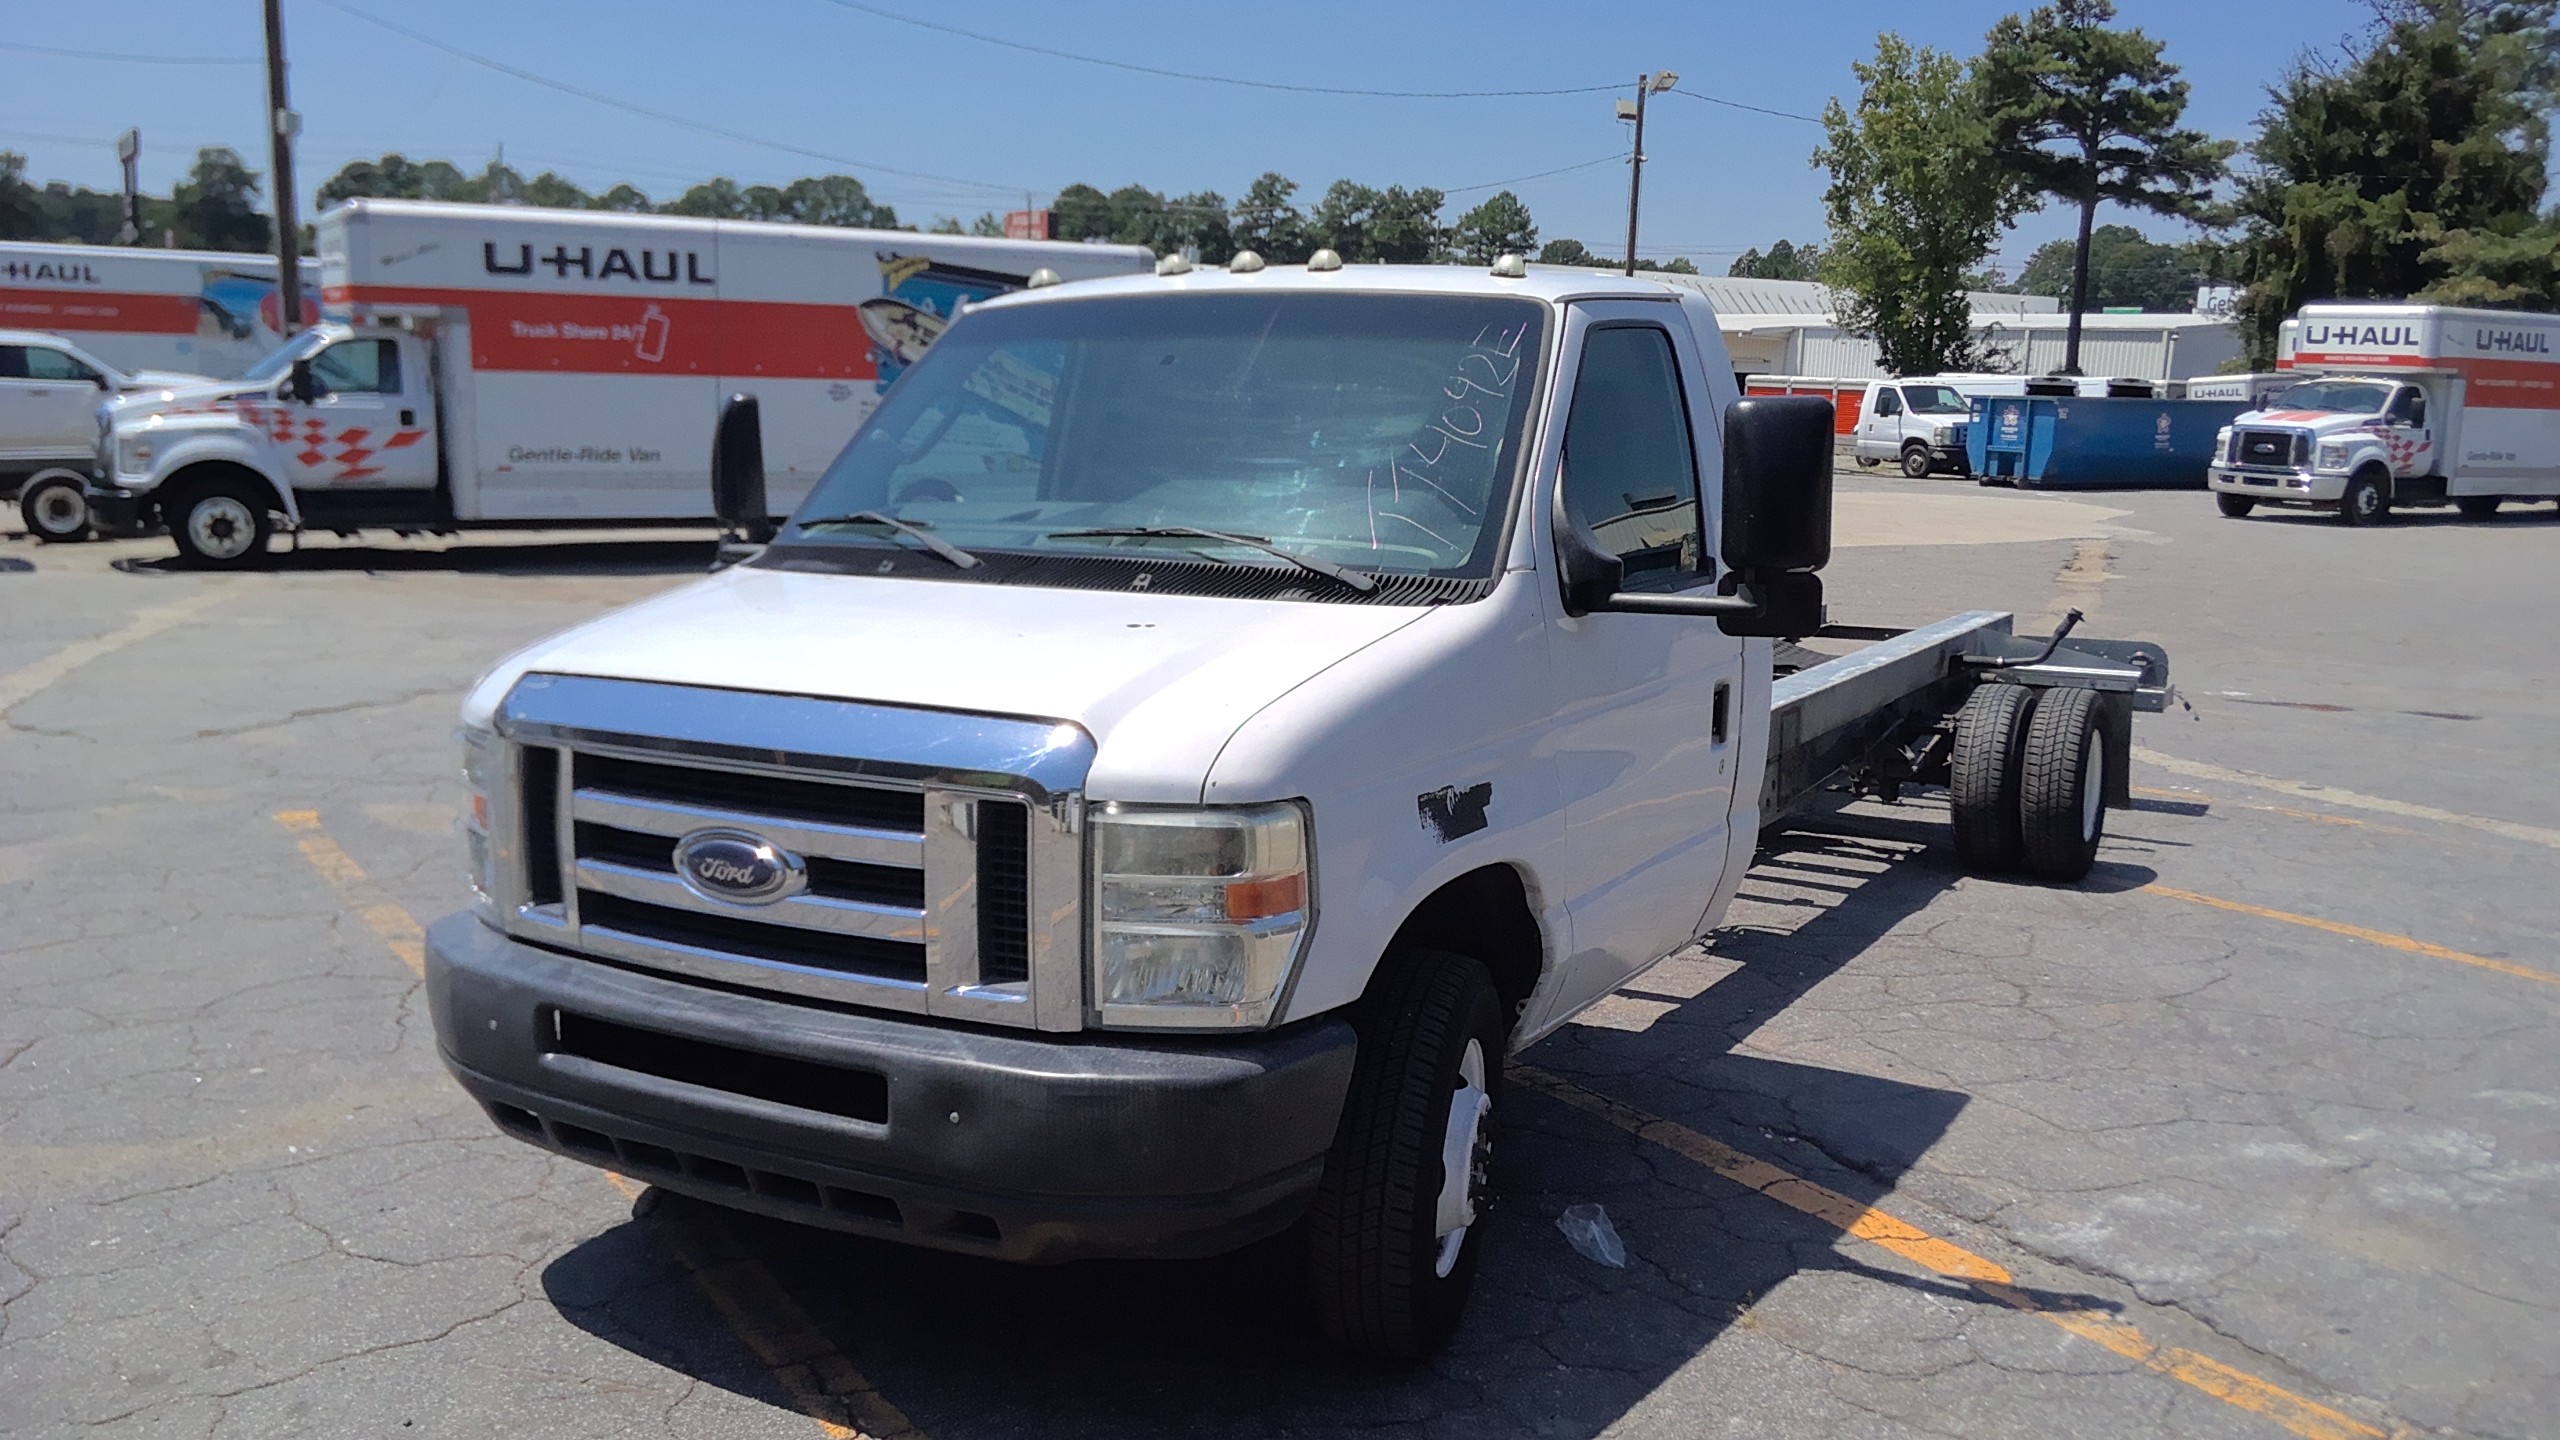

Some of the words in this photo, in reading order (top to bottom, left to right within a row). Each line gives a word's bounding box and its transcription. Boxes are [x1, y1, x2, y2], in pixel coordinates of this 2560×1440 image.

[0, 261, 102, 284] -HAUL
[484, 241, 717, 284] U-HAUL
[2306, 325, 2419, 346] U-HAUL
[2476, 328, 2549, 354] U-HAUL
[2194, 388, 2243, 399] U-HAUL
[700, 857, 755, 885] Ford
